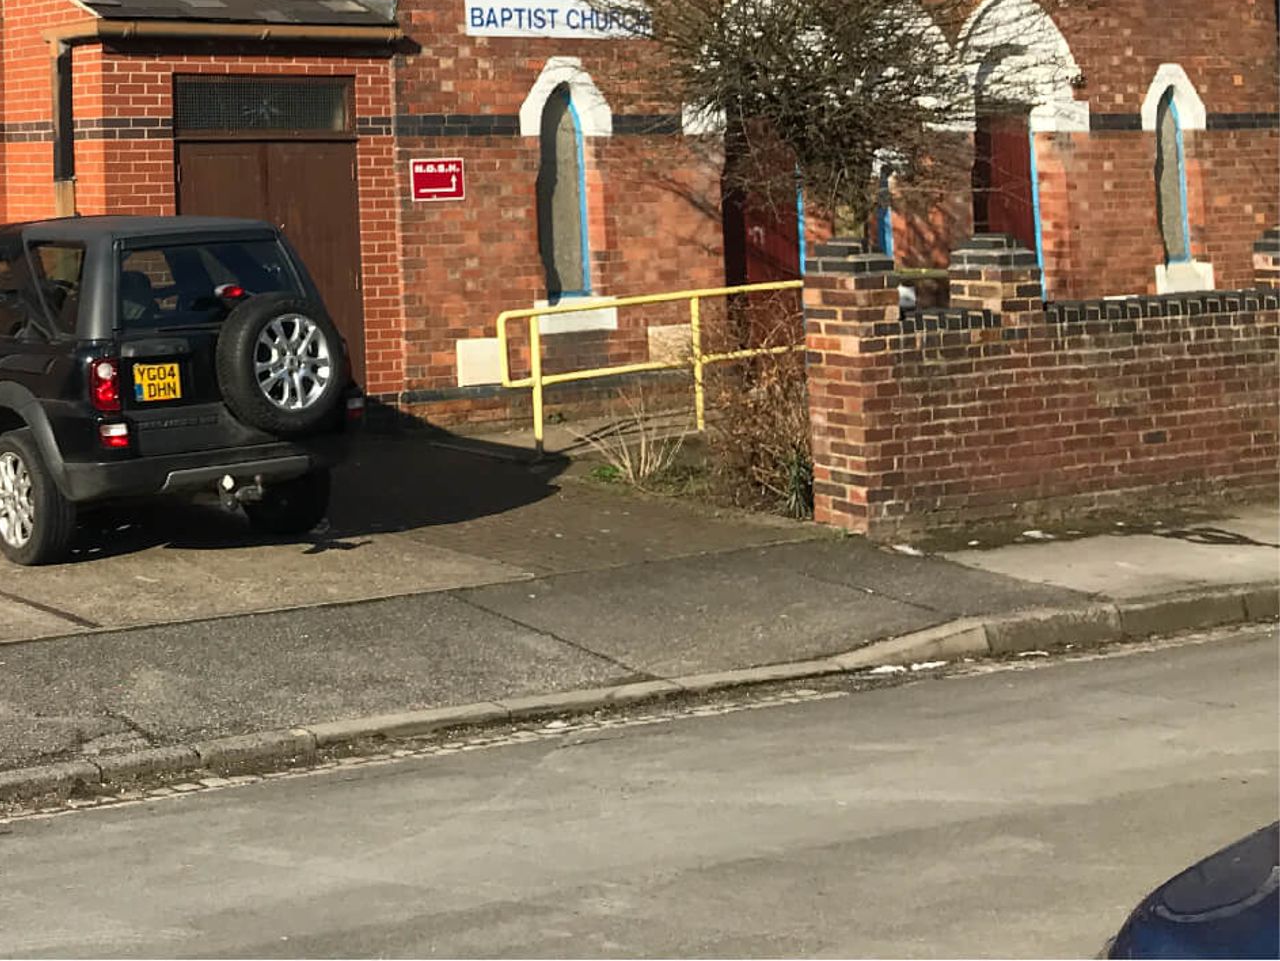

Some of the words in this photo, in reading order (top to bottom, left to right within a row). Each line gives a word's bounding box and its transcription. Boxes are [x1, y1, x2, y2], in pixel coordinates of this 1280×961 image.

[470, 6, 559, 30] BAPTIST
[137, 366, 177, 381] YG04
[148, 382, 177, 398] DHN
